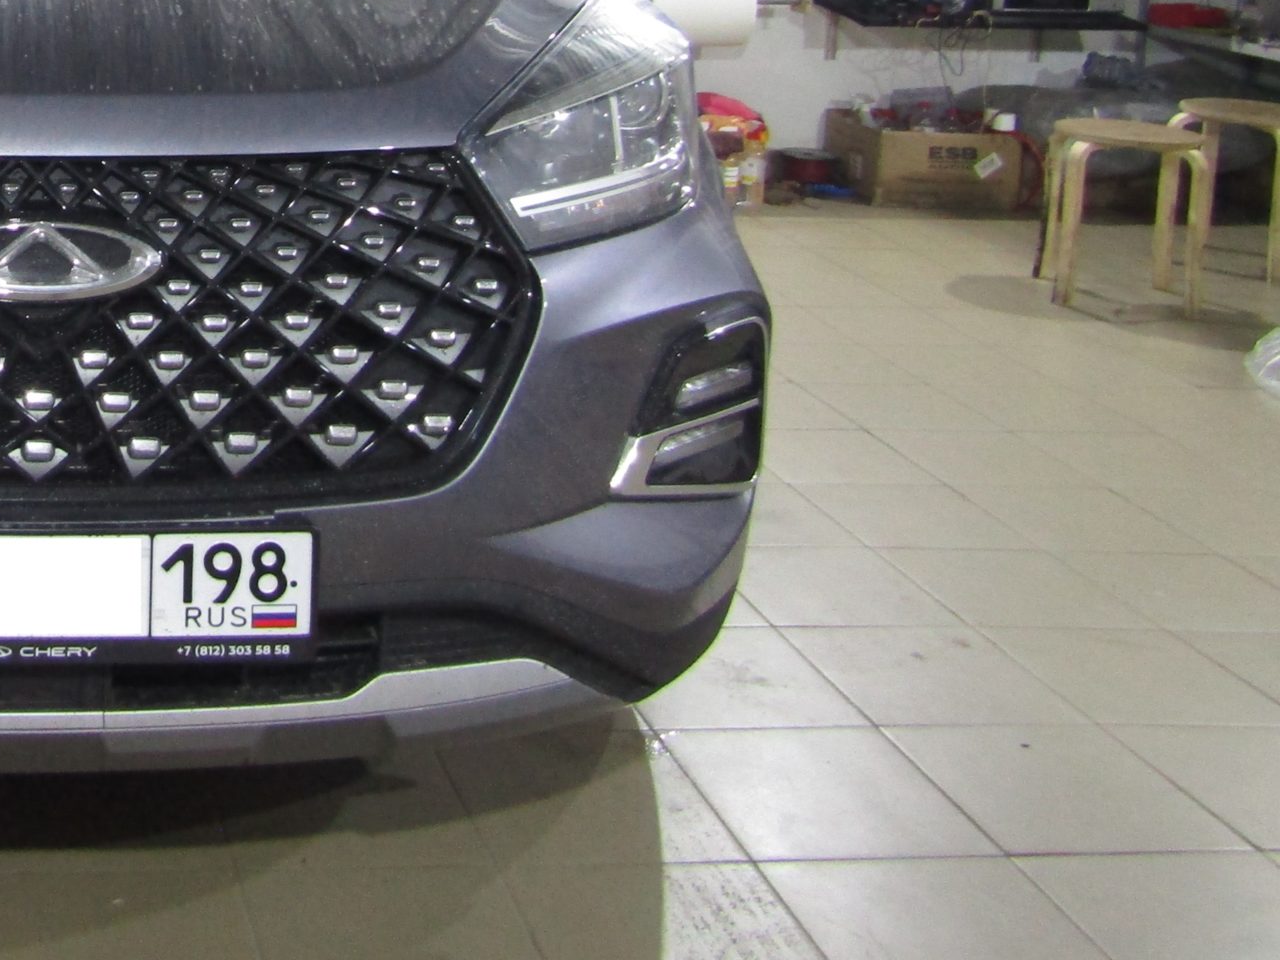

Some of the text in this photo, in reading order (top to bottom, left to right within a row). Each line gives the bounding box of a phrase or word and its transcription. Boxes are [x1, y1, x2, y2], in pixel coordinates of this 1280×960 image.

[161, 541, 288, 604] 198
[185, 606, 247, 628] RUS
[19, 646, 97, 657] CHERY
[177, 644, 291, 658] +7 (812) 303 58 58
